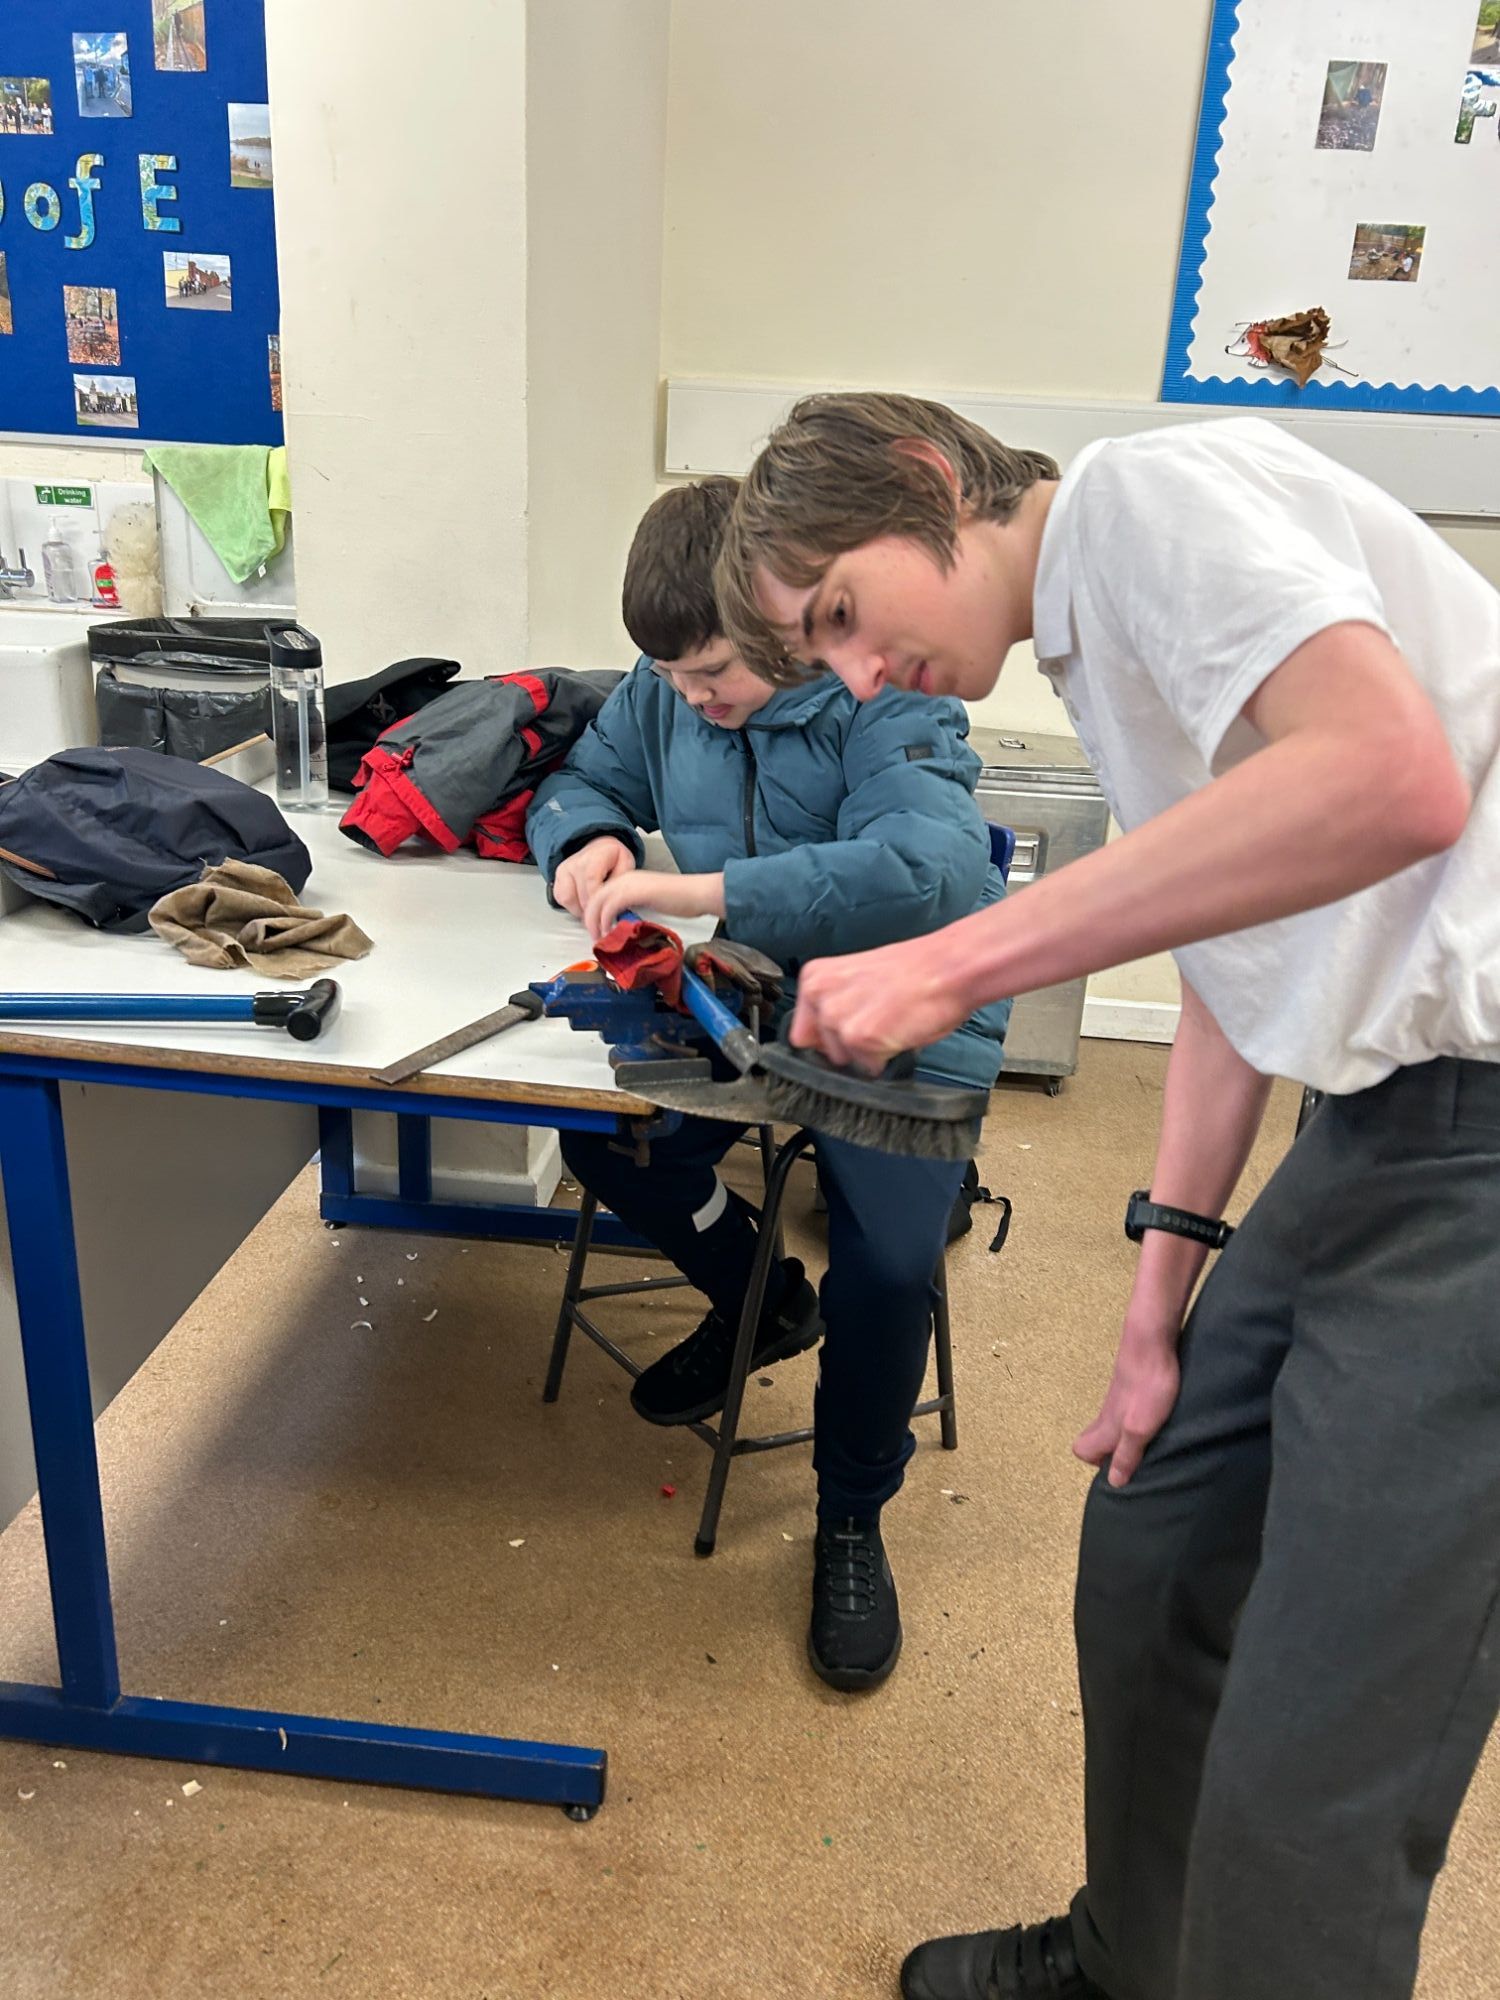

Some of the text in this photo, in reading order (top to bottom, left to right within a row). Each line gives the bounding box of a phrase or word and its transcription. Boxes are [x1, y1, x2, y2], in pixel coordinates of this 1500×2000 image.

[1454, 70, 1500, 144] F
[24, 153, 104, 249] of
[138, 153, 180, 231] E
[57, 488, 87, 497] Drinking
